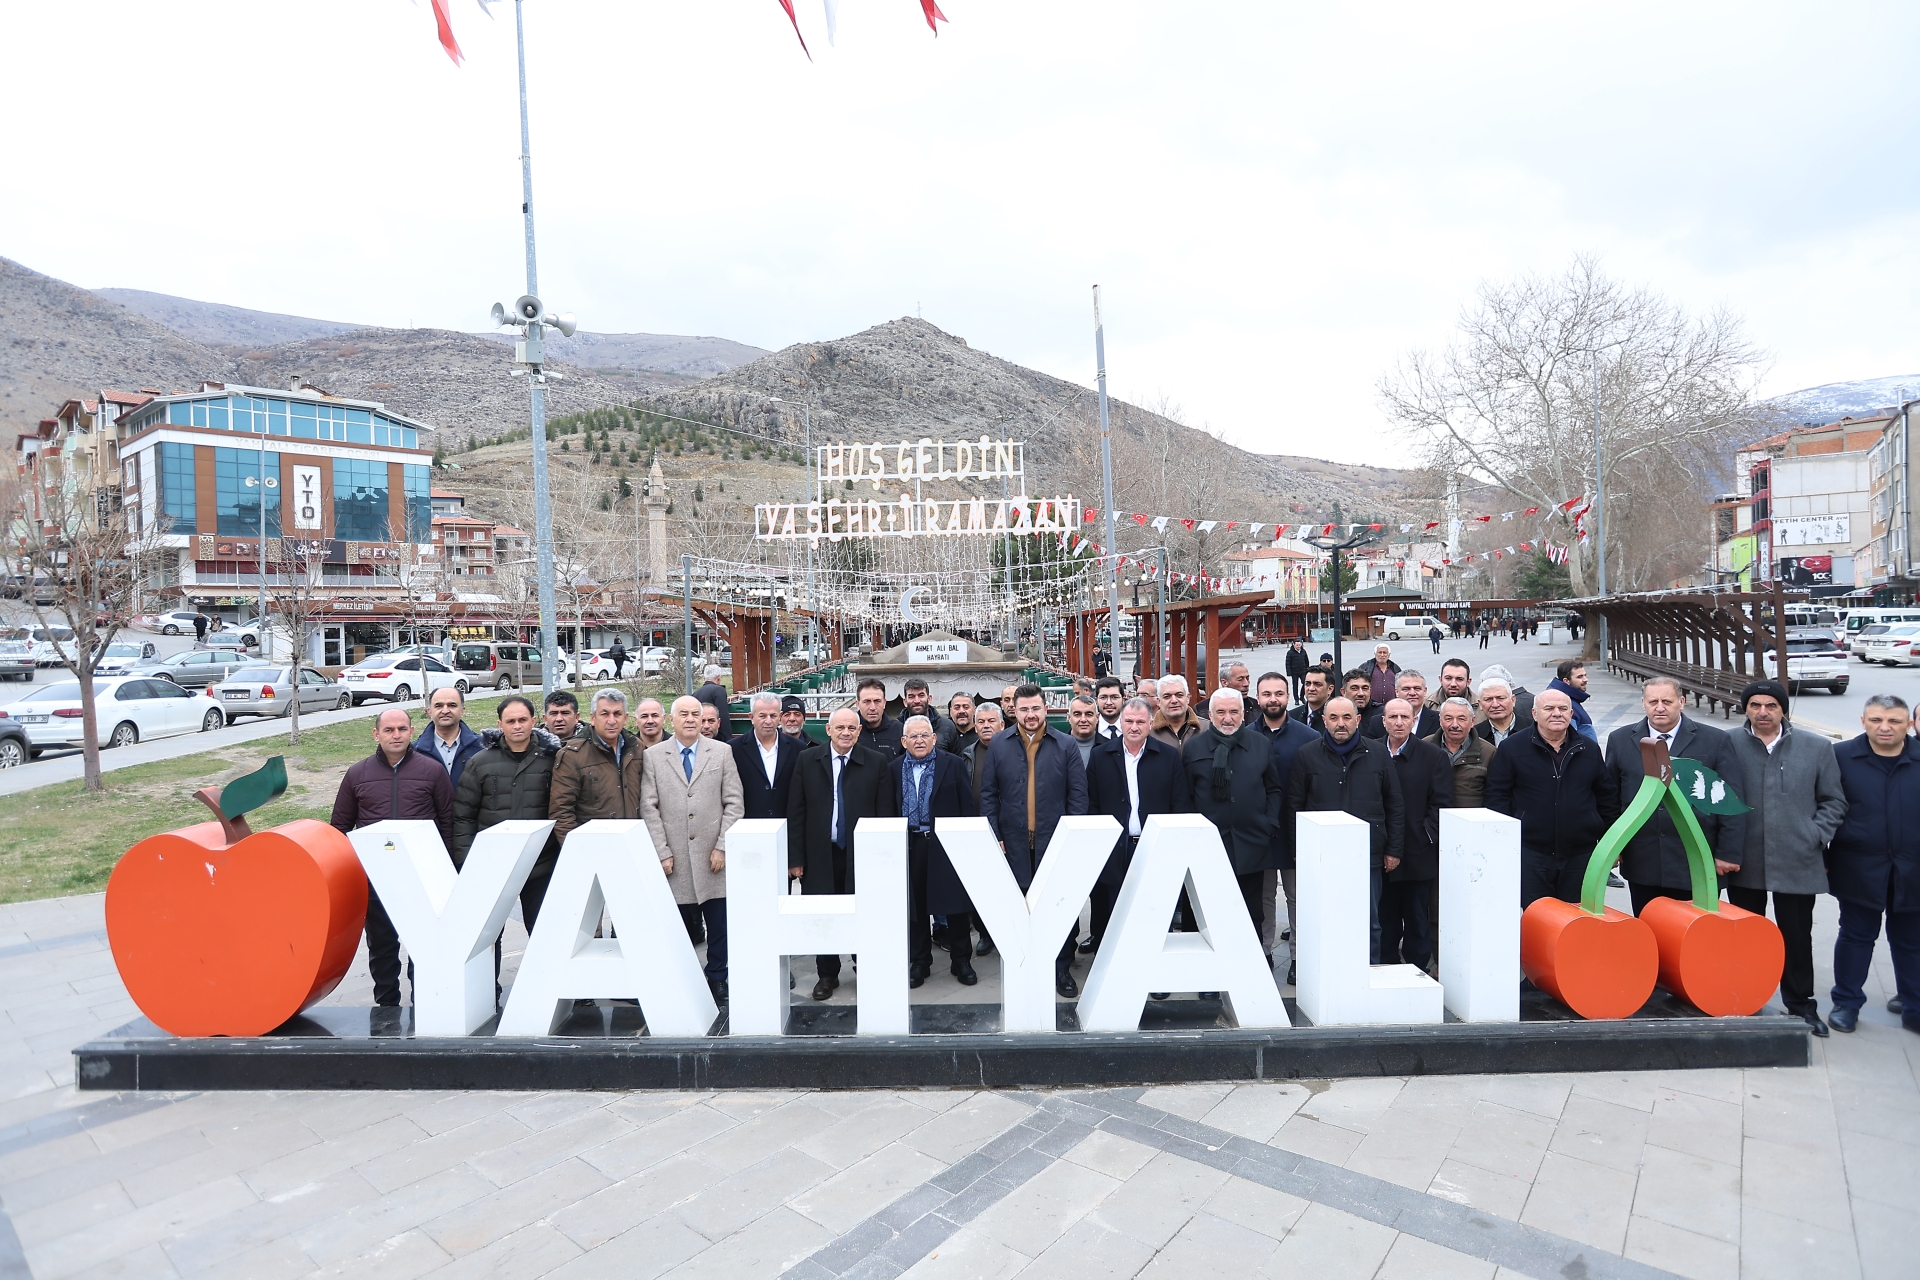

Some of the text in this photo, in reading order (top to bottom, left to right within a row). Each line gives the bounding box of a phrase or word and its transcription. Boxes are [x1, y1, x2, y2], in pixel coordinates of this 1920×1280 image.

[293, 443, 344, 456] TİCARET
[347, 448, 380, 460] ODASI
[826, 434, 1014, 490] HOŞ GELDİN
[765, 501, 797, 543] YA
[925, 493, 1073, 538] RAMAZAN
[332, 602, 375, 611] MERKEZ İLETİŞİM
[948, 644, 960, 652] BAL
[347, 807, 1522, 1038] YAHYALI
